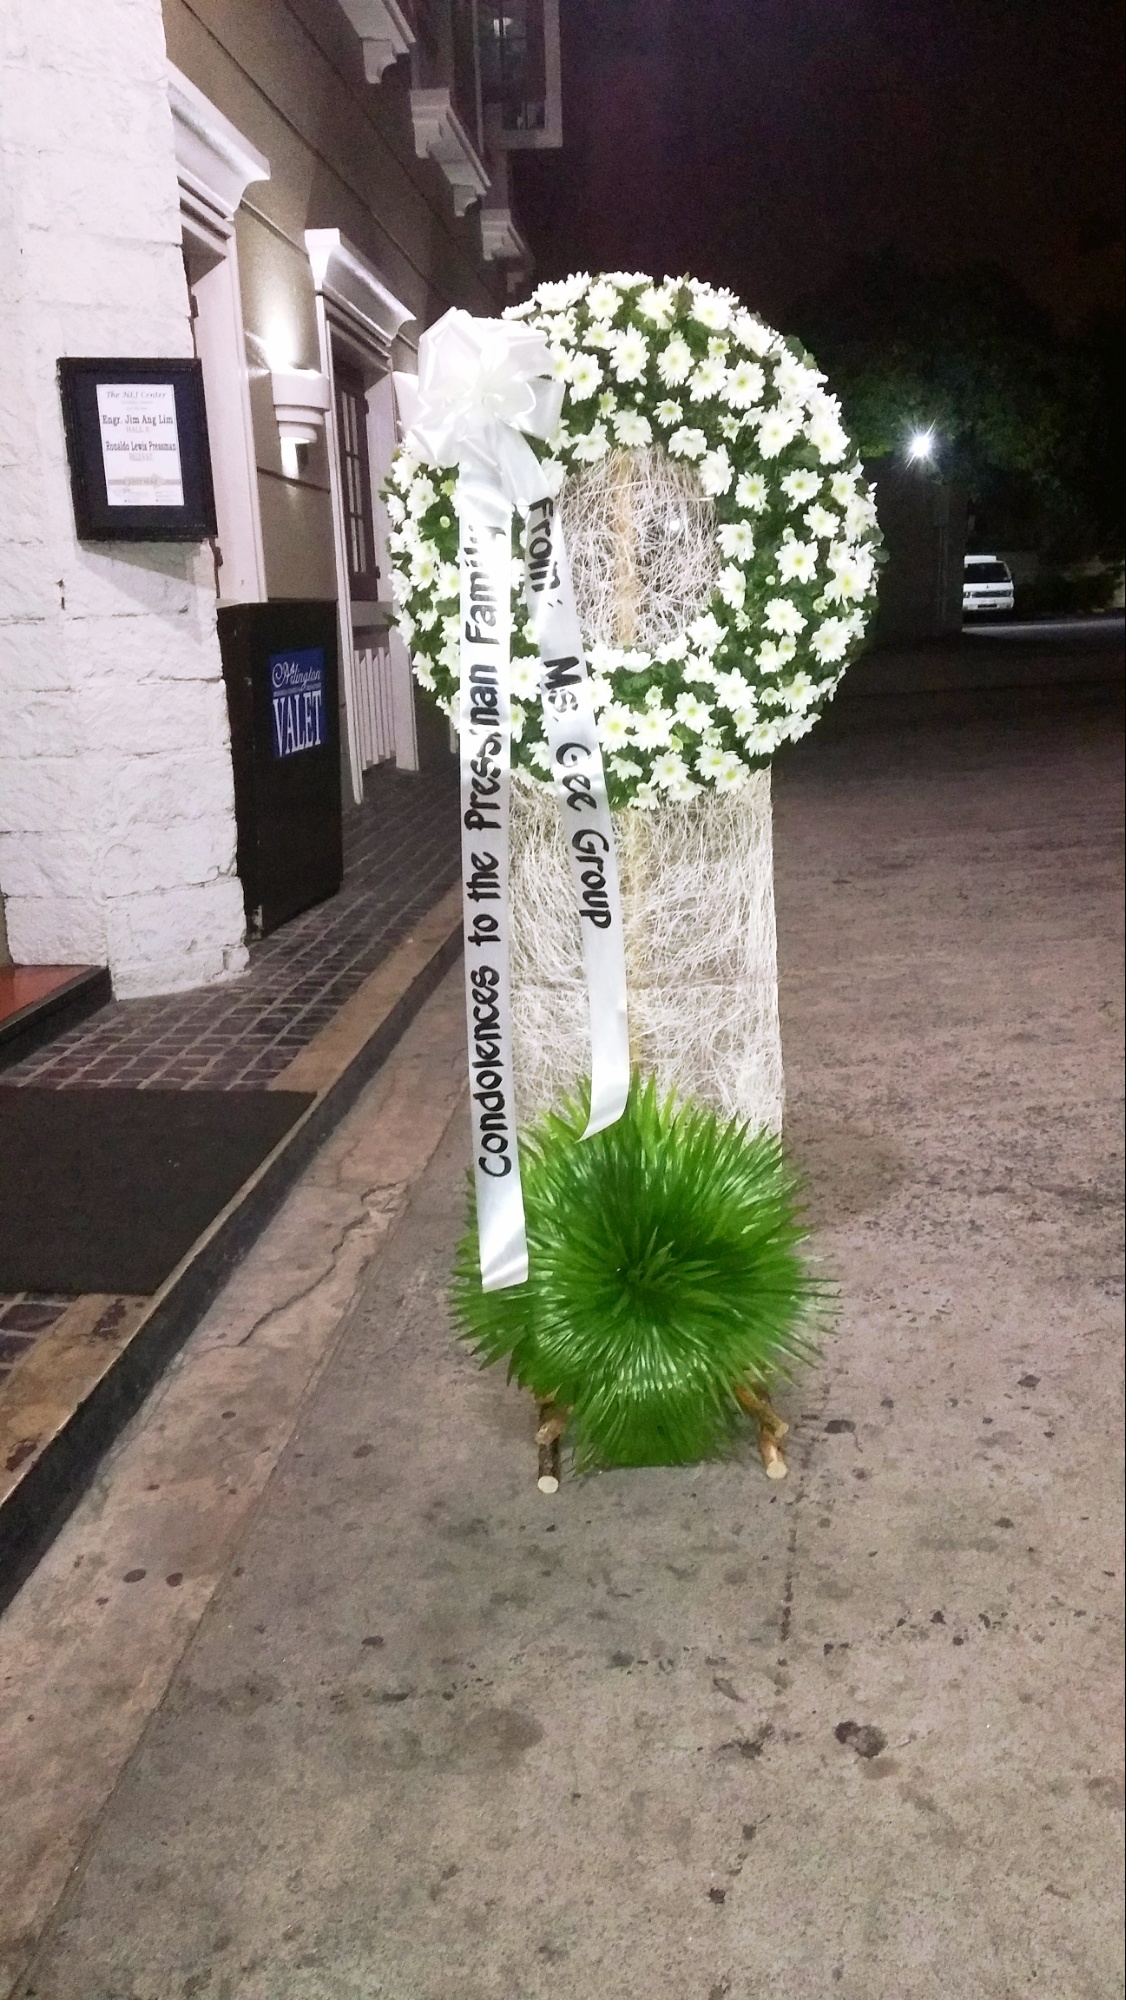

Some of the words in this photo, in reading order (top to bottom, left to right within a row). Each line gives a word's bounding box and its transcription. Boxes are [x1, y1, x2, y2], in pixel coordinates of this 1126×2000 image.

[102, 414, 123, 427] Engr.
[125, 414, 140, 425] Jim
[142, 414, 157, 427] Ang
[158, 414, 174, 425] Lim
[106, 391, 120, 399] The
[140, 391, 167, 399] Center
[105, 440, 130, 451] Ronaldo
[131, 440, 148, 451] Lewis
[148, 440, 177, 452] Pressman
[272, 690, 322, 758] VALET
[555, 742, 598, 812] Gee
[467, 850, 502, 902] the
[570, 828, 612, 930] Group
[467, 912, 502, 947] to
[469, 964, 512, 1178] Condolences
